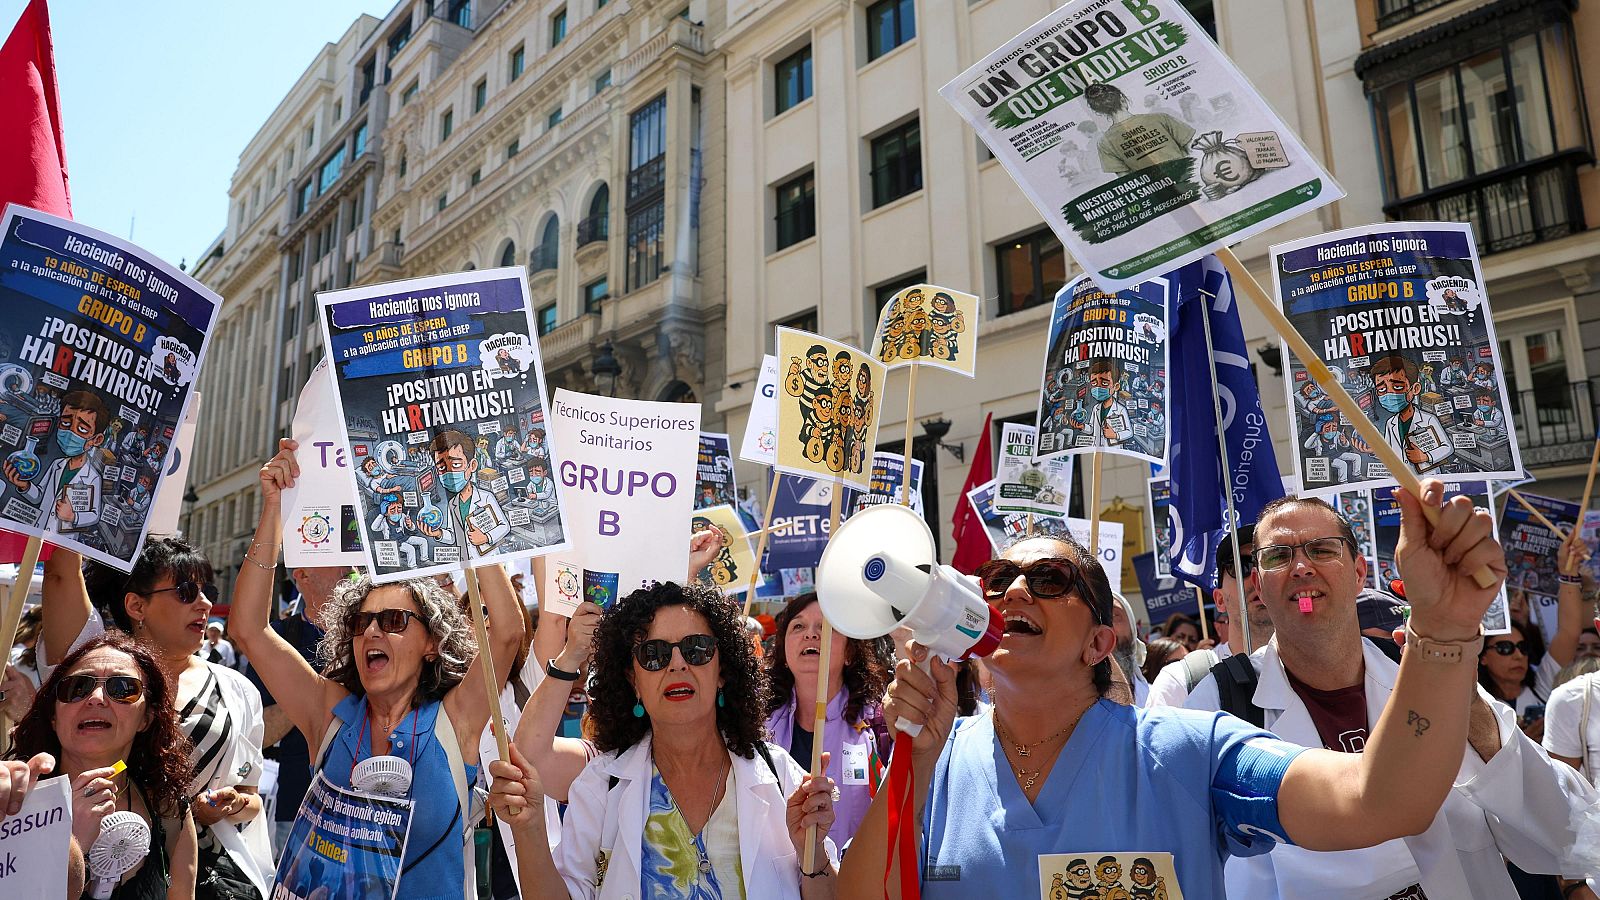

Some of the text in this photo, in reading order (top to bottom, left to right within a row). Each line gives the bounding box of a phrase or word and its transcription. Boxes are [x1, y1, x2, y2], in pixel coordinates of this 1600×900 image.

[967, 0, 1160, 109] UN GRUPO B
[985, 17, 1074, 75] TÉCNICOS SUPERIORES
[1007, 25, 1178, 120] QUE NADIE VE
[1142, 55, 1188, 81] GRUPO B
[1120, 128, 1161, 151] ESENCIALES
[1121, 125, 1147, 140] SOMOS
[1123, 134, 1169, 159] NO INVISIBLES
[1076, 174, 1151, 213] NUESTRO TRABAJO
[1083, 176, 1177, 222] MANTIENE LA SANIDAD,
[1092, 217, 1112, 232] ¿POR
[1127, 203, 1141, 215] NO
[1141, 198, 1152, 209] SE
[1096, 189, 1194, 239] NOS PAGA LO QUE MERECEMOS?
[1317, 236, 1428, 262] Hacienda nos ignora
[44, 256, 142, 301] 19 AÑOS DE ESPERA
[63, 235, 180, 305] Hacienda nos ignora
[1297, 288, 1305, 296] la
[1305, 277, 1344, 294] aplicación
[1345, 275, 1358, 283] del
[1358, 271, 1373, 281] Art.
[1374, 269, 1384, 278] 76
[1385, 267, 1398, 276] del
[1399, 265, 1417, 275] EBEP
[1310, 257, 1394, 283] 19 AÑOS DE ESPERA
[11, 259, 159, 321] a la aplicación del Art. 76 del EBEP
[1347, 281, 1414, 303] GRUPO B
[1431, 279, 1469, 291] HACIENDA
[77, 294, 148, 344] GRUPO B
[368, 291, 480, 319] Hacienda nos ignora
[1083, 308, 1127, 323] GRUPO B
[362, 317, 447, 343] 19 AÑOS DE ESPERA
[1330, 304, 1441, 336] ¡POSITIVO EN
[39, 316, 154, 383] ¡POSITIVO EN
[160, 339, 192, 361] HACIENDA
[343, 324, 470, 358] a la aplicación del Art. 76 del EBEP
[485, 336, 522, 352] HACIENDA
[1070, 327, 1124, 348] ¡POSITIVO
[1323, 324, 1462, 362] HARTAVIRUS!!
[402, 344, 468, 369] GRUPO B
[1064, 341, 1149, 366] HARTAVIRUS!!
[19, 334, 164, 416] HARTAVIRUS!!
[386, 369, 494, 408] ¡POSITIVO EN
[381, 388, 515, 435] HARTAVIRUS!!
[555, 400, 696, 431] Técnicos Superiores
[579, 429, 653, 452] Sanitarios
[1008, 431, 1022, 444] UN
[1012, 445, 1028, 456] QUE
[559, 459, 677, 499] GRUPO
[885, 483, 892, 492] B
[598, 509, 621, 537] B
[1514, 541, 1550, 557] ALBACETE
[1146, 588, 1195, 610] SIETeSS
[333, 797, 373, 821] jaramonik
[373, 810, 403, 828] egiten
[322, 820, 383, 842] artikulua aplikatu
[308, 831, 349, 864] B Taldea
